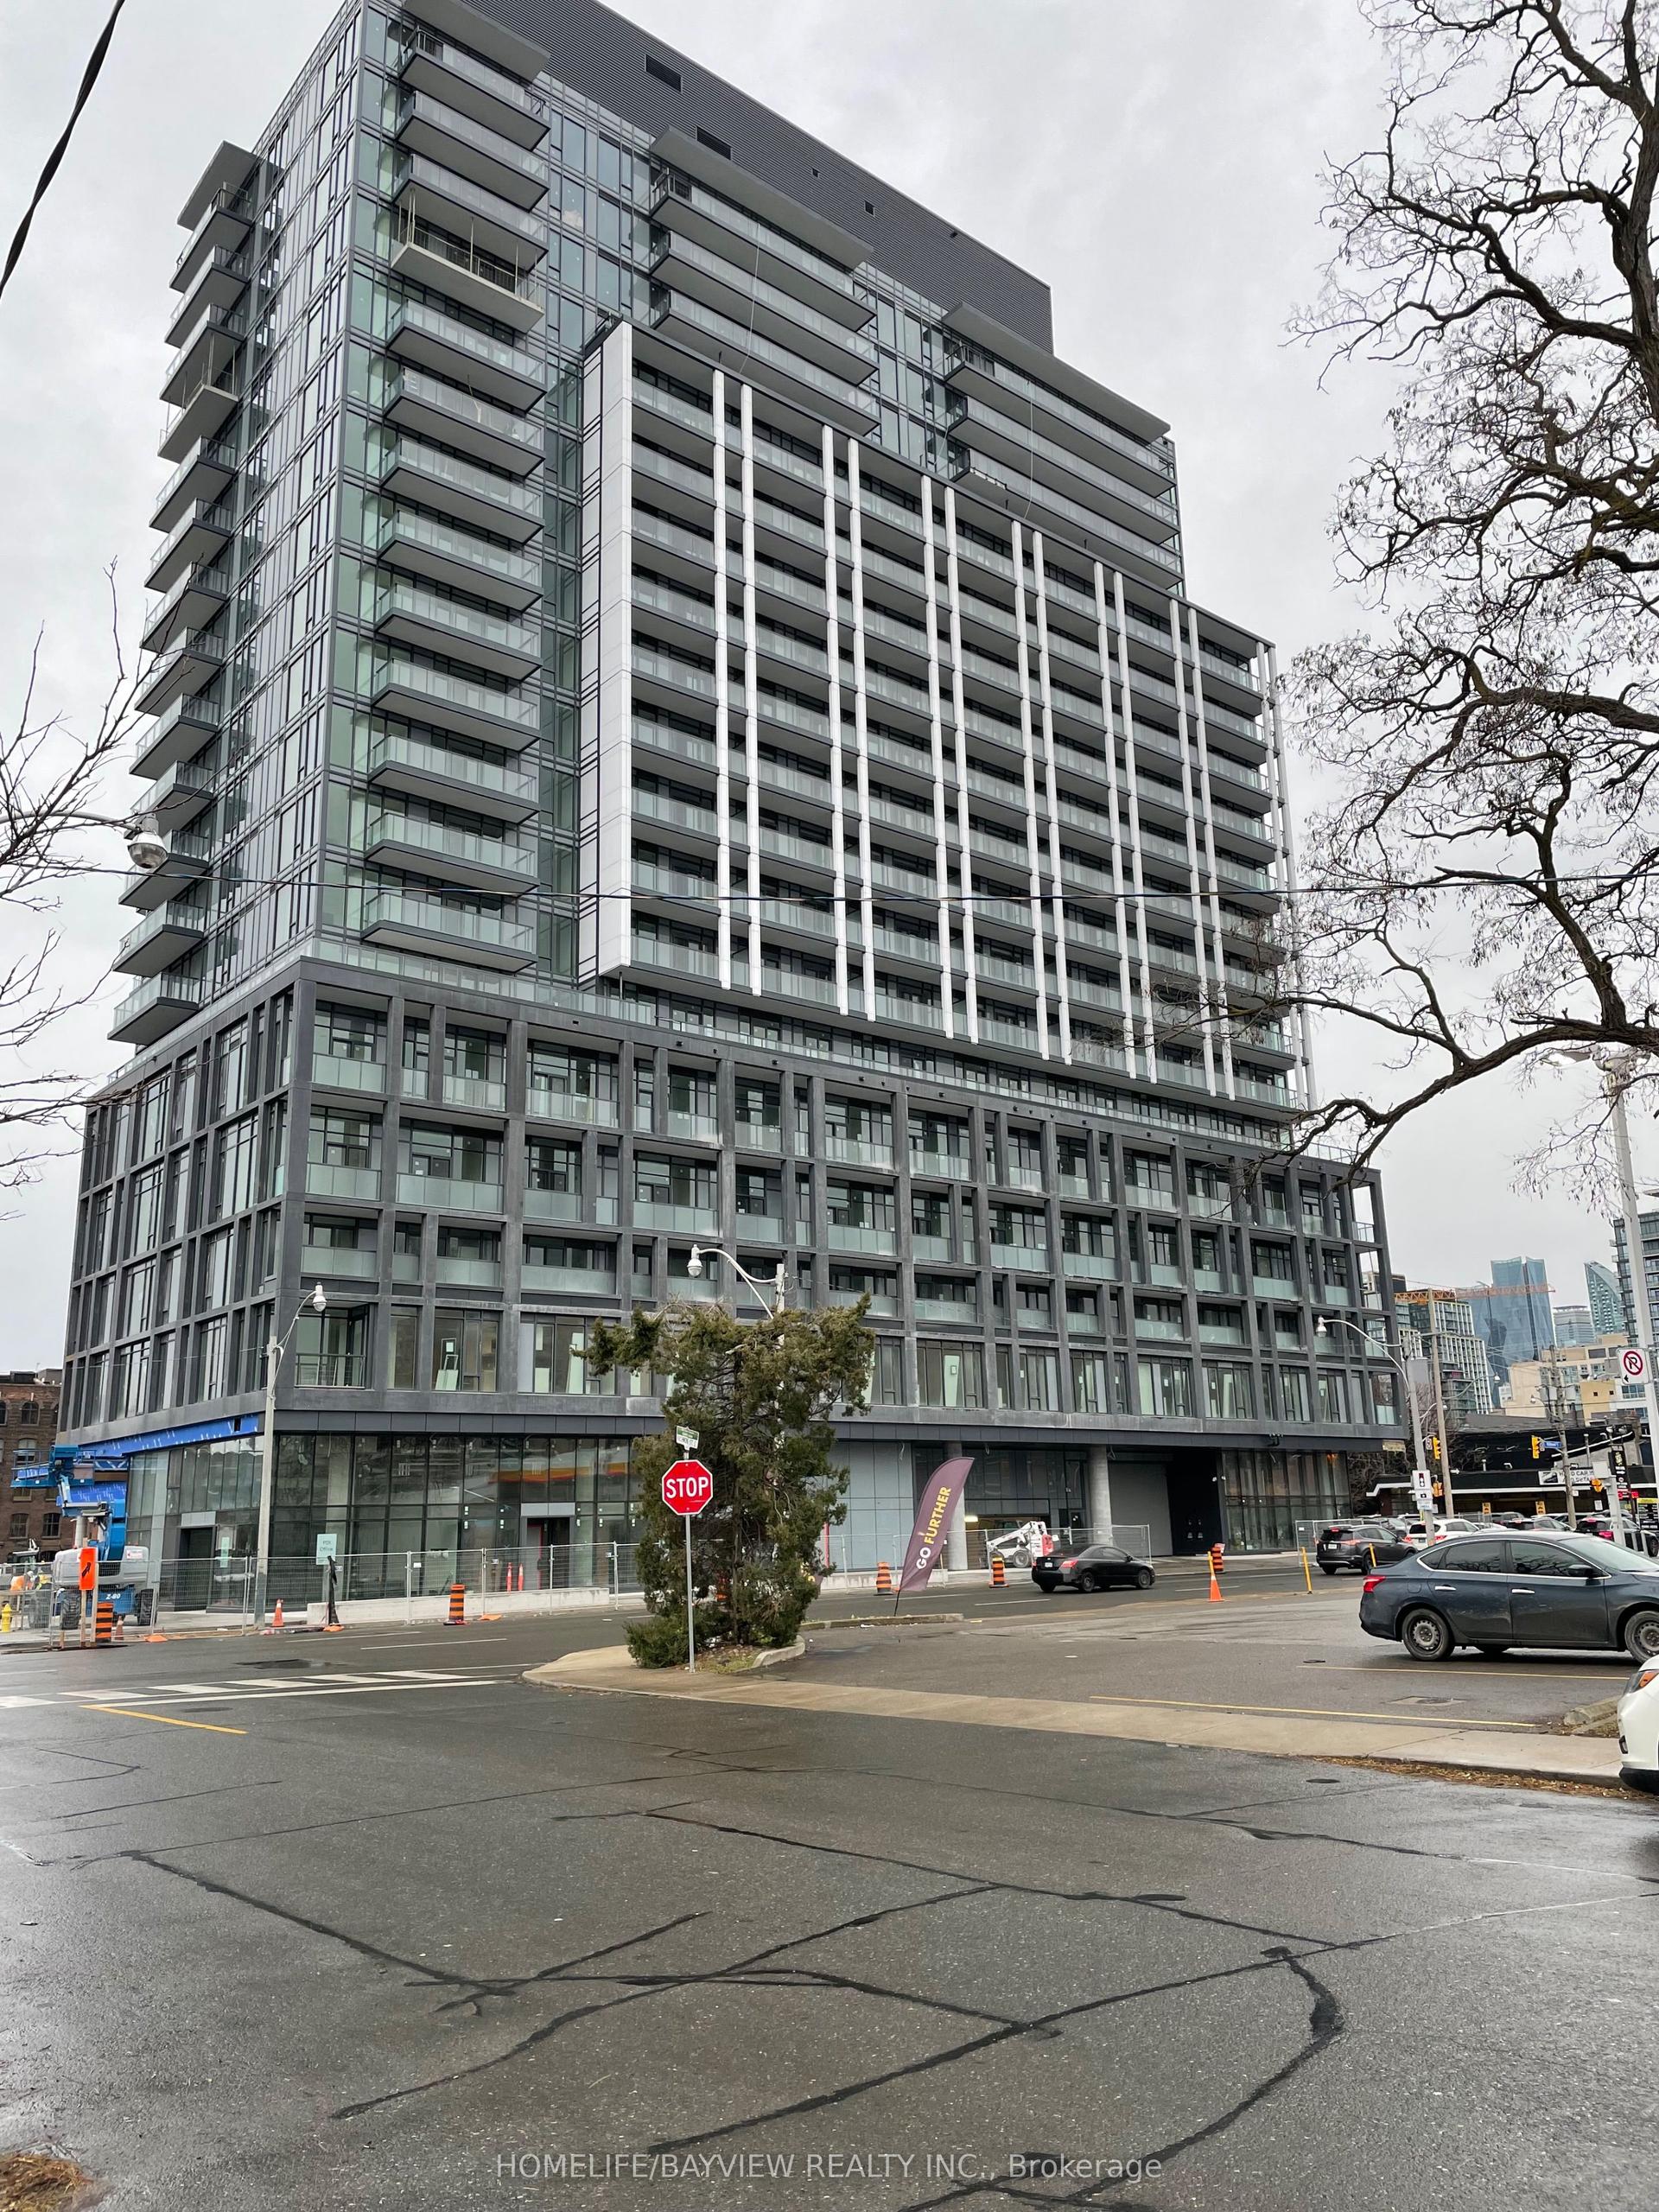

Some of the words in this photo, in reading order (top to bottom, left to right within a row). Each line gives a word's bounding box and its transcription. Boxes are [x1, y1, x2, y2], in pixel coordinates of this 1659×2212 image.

[666, 1476, 709, 1498] STOP
[916, 1547, 931, 1569] GO
[924, 1486, 951, 1545] FURTHER
